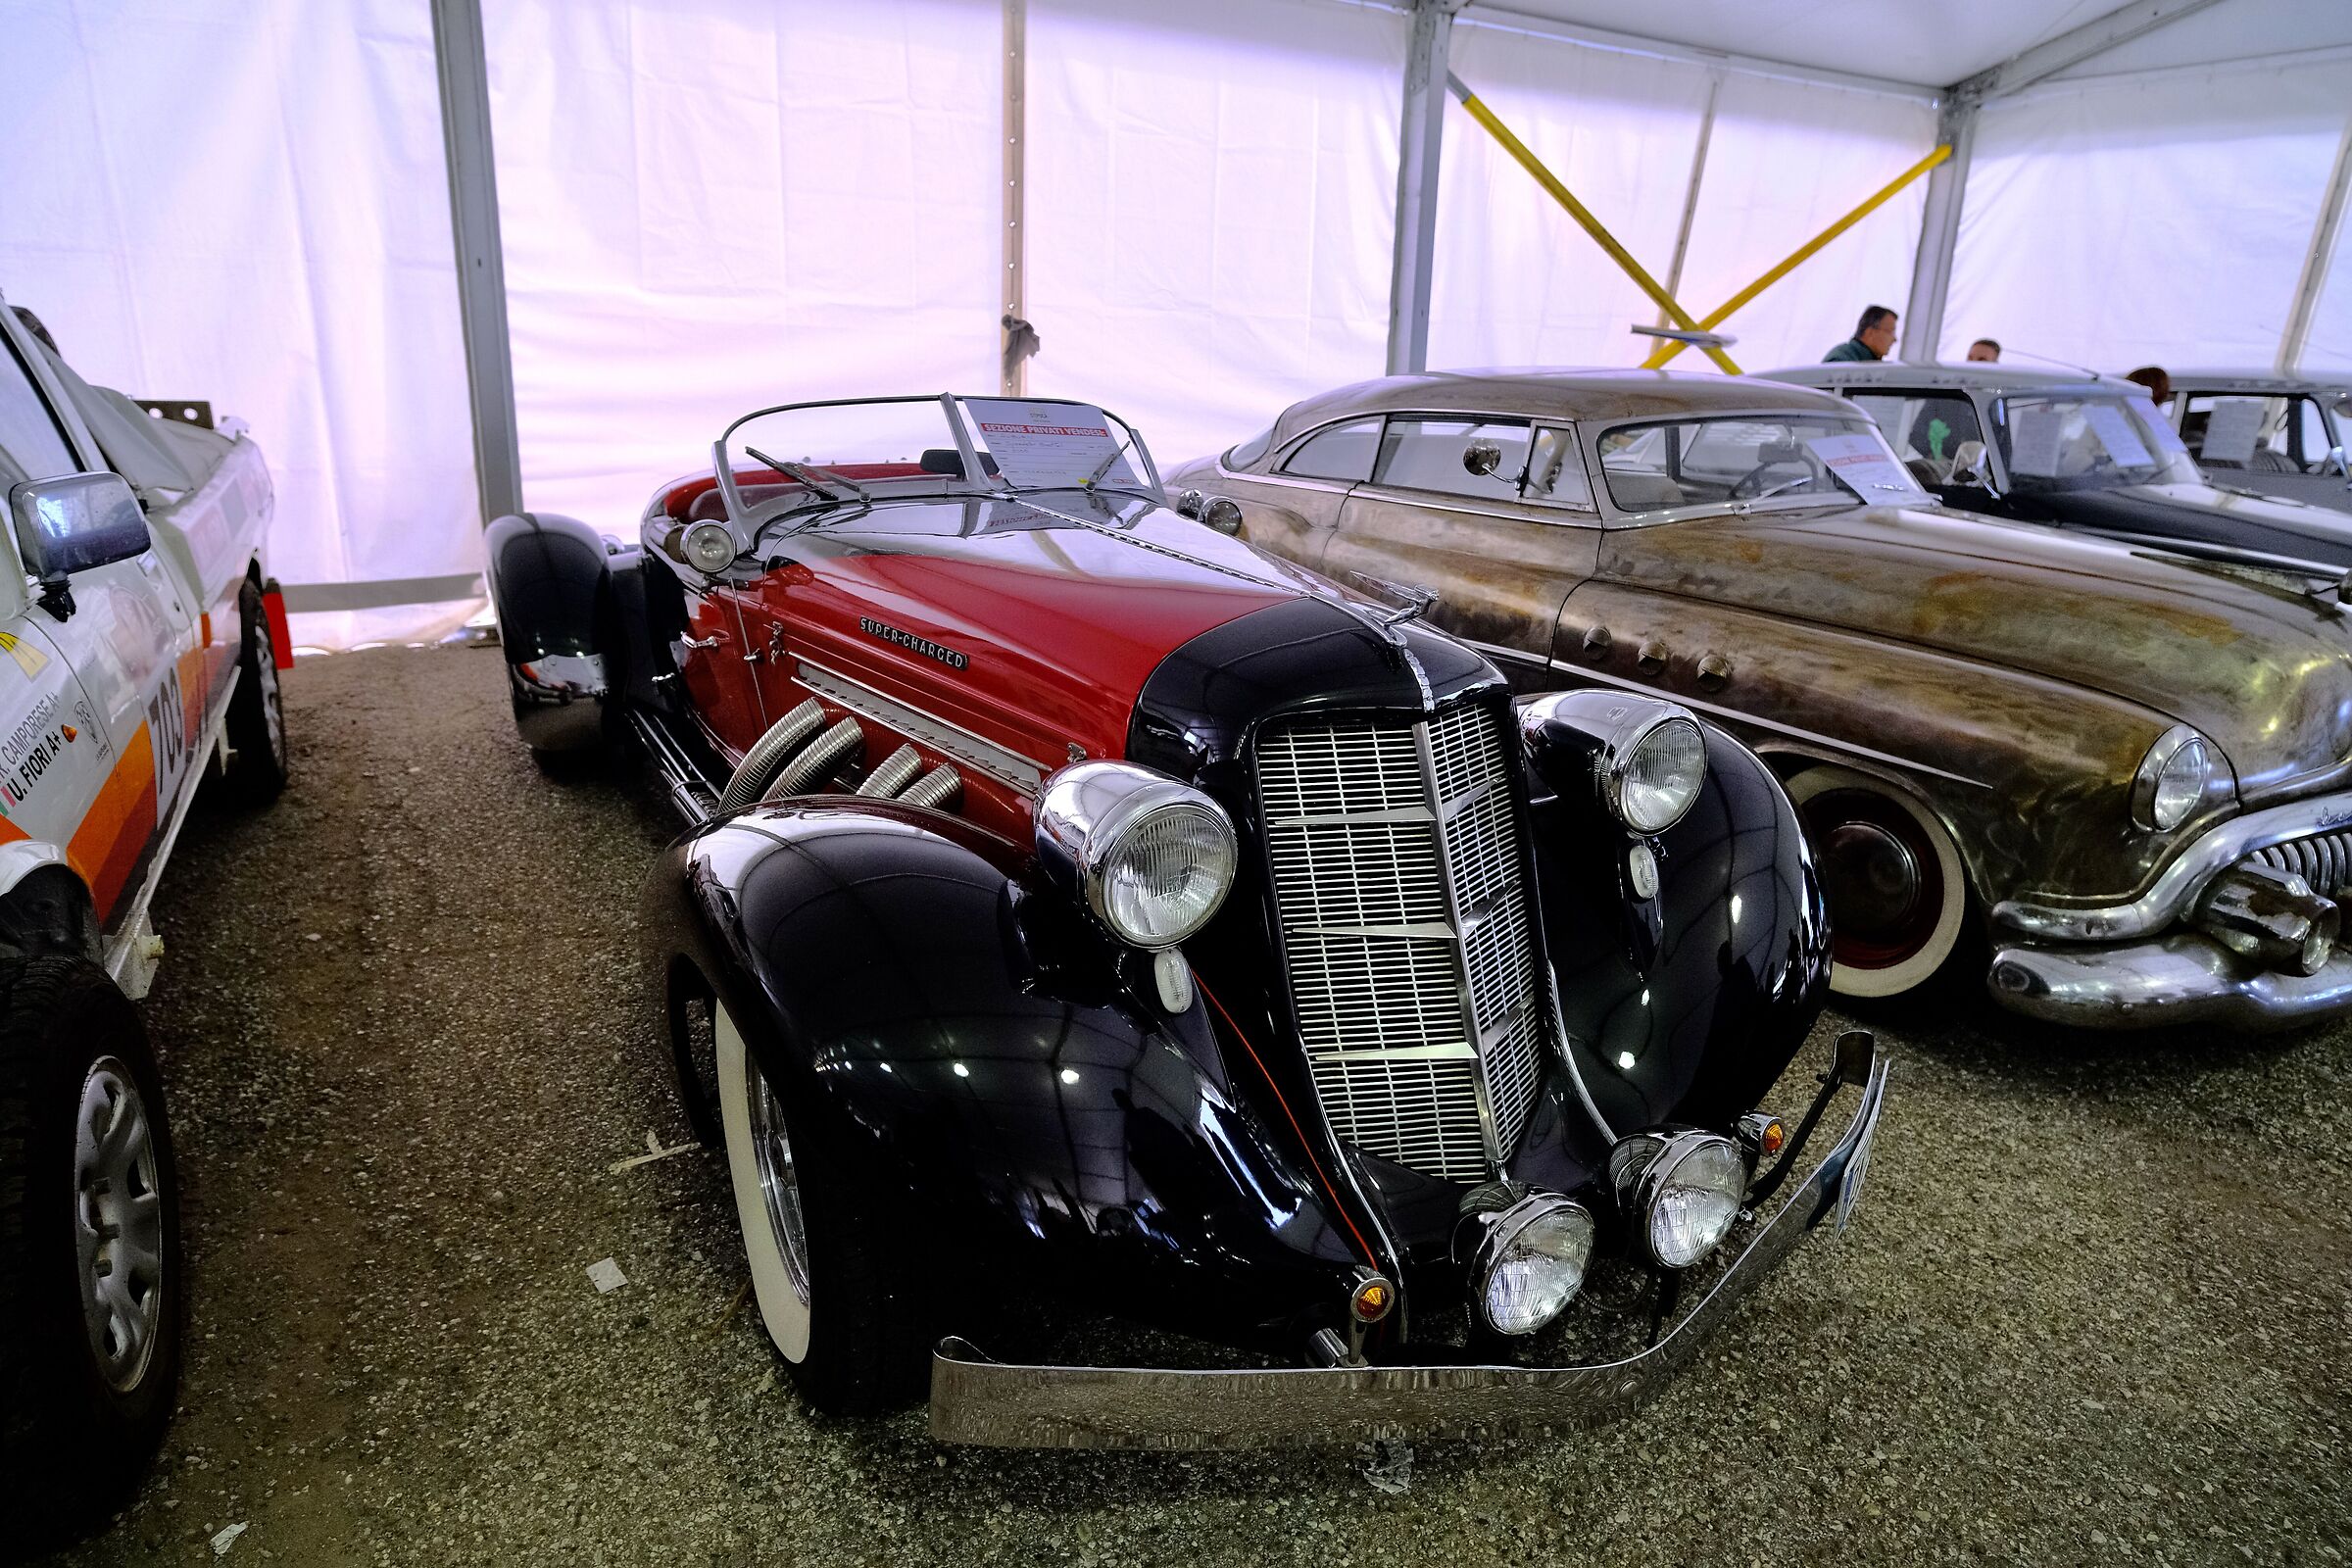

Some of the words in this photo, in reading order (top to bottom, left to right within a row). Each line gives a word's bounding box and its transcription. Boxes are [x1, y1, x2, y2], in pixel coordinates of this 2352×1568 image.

[983, 424, 1028, 433] SEZIONE
[1026, 425, 1064, 435] PRIVATI
[860, 617, 963, 667] SUPER-CHARGED
[1, 700, 54, 765] CAMPORESE
[7, 777, 28, 802] U.
[19, 743, 53, 788] FIORI
[45, 730, 61, 757] A+
